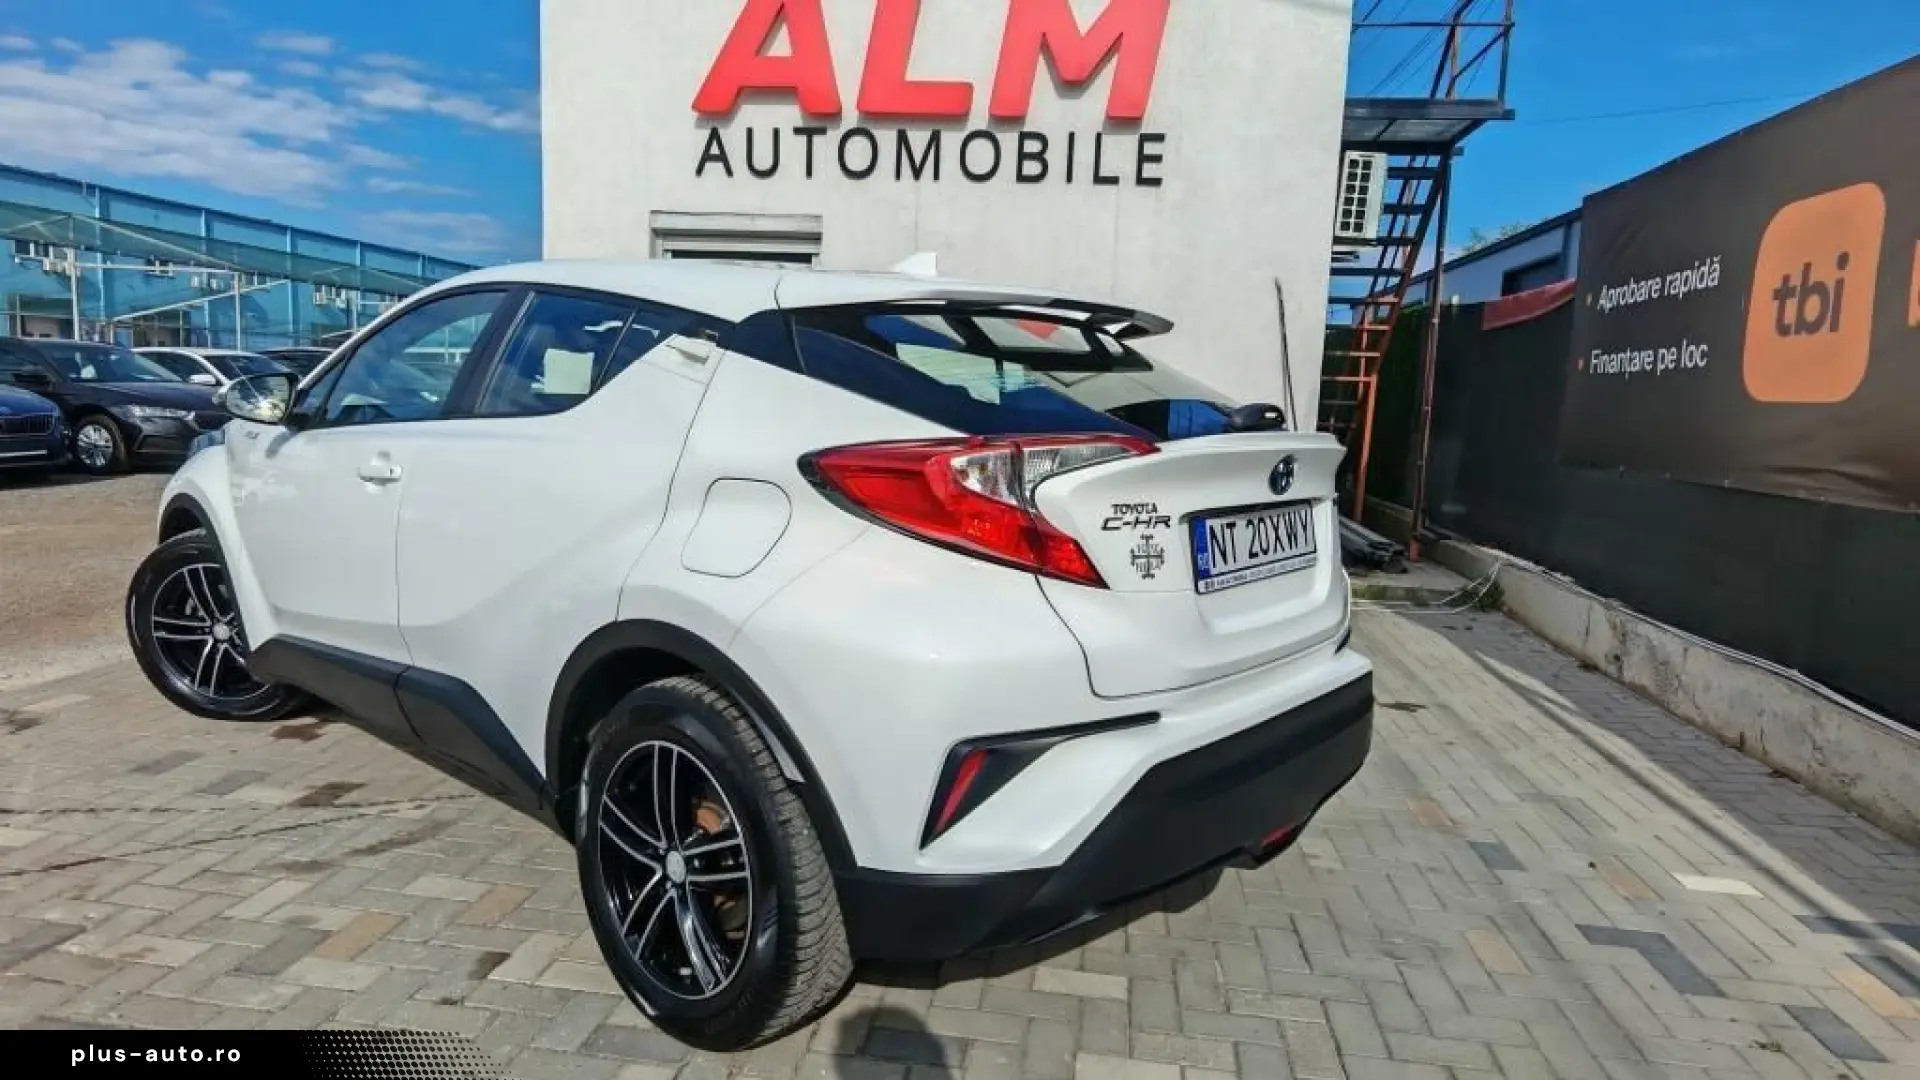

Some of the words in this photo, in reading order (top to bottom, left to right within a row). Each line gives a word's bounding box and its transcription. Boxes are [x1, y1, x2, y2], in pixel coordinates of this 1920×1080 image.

[691, 0, 1170, 119] ALM
[695, 127, 1166, 186] AUTOMOBILE
[1597, 276, 1662, 314] Aprobare
[1664, 255, 1722, 299] rapidă
[1772, 251, 1849, 337] tbi
[1590, 347, 1655, 380] Finanțare
[1657, 346, 1677, 375] pe
[1681, 338, 1708, 368] loc
[1101, 515, 1171, 531] C-HR
[1111, 502, 1158, 515] TOYOTA
[1209, 520, 1236, 568] NT
[1245, 509, 1308, 559] 20XWY
